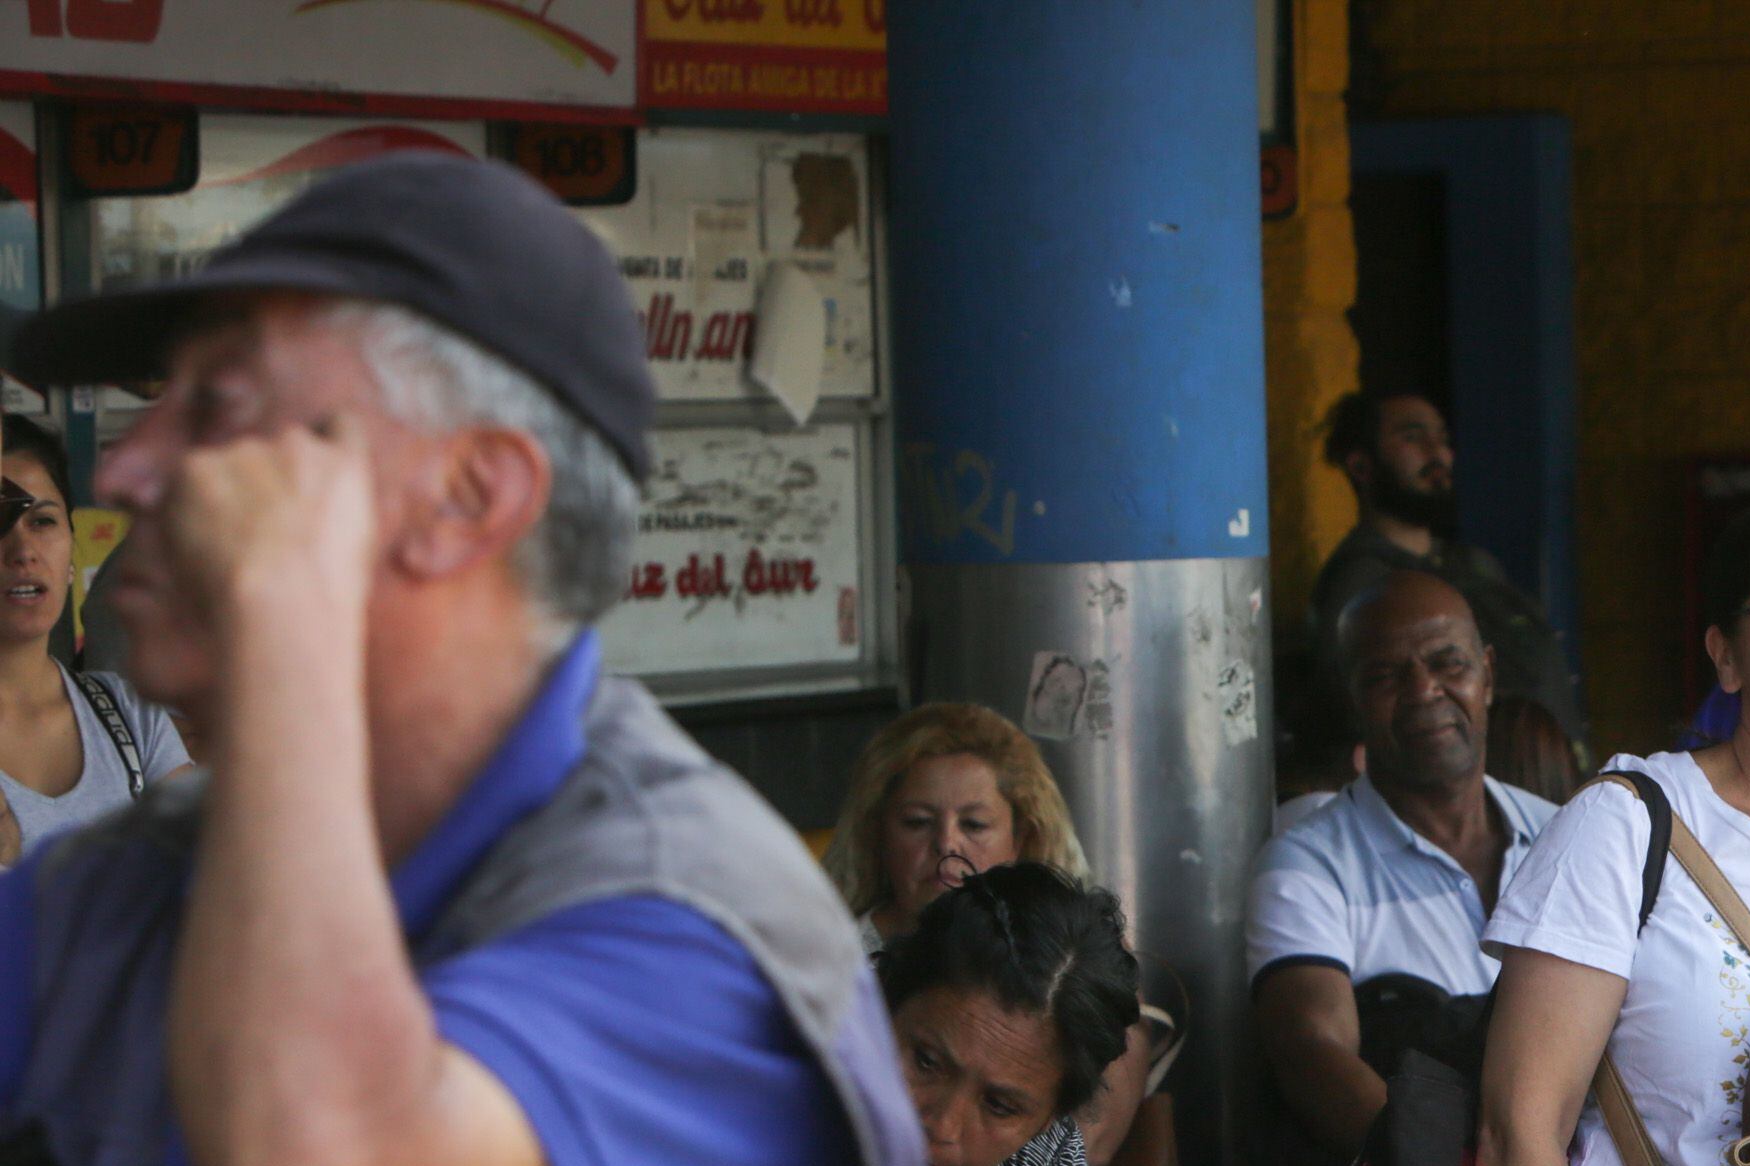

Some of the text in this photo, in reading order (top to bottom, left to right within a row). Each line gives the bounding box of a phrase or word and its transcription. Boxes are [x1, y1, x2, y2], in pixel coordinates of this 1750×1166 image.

[653, 61, 677, 95] LA
[683, 61, 743, 96] FLOTA
[748, 64, 811, 98] AMIGA
[814, 68, 838, 99] DE
[90, 121, 161, 166] 107
[538, 135, 608, 177] 108
